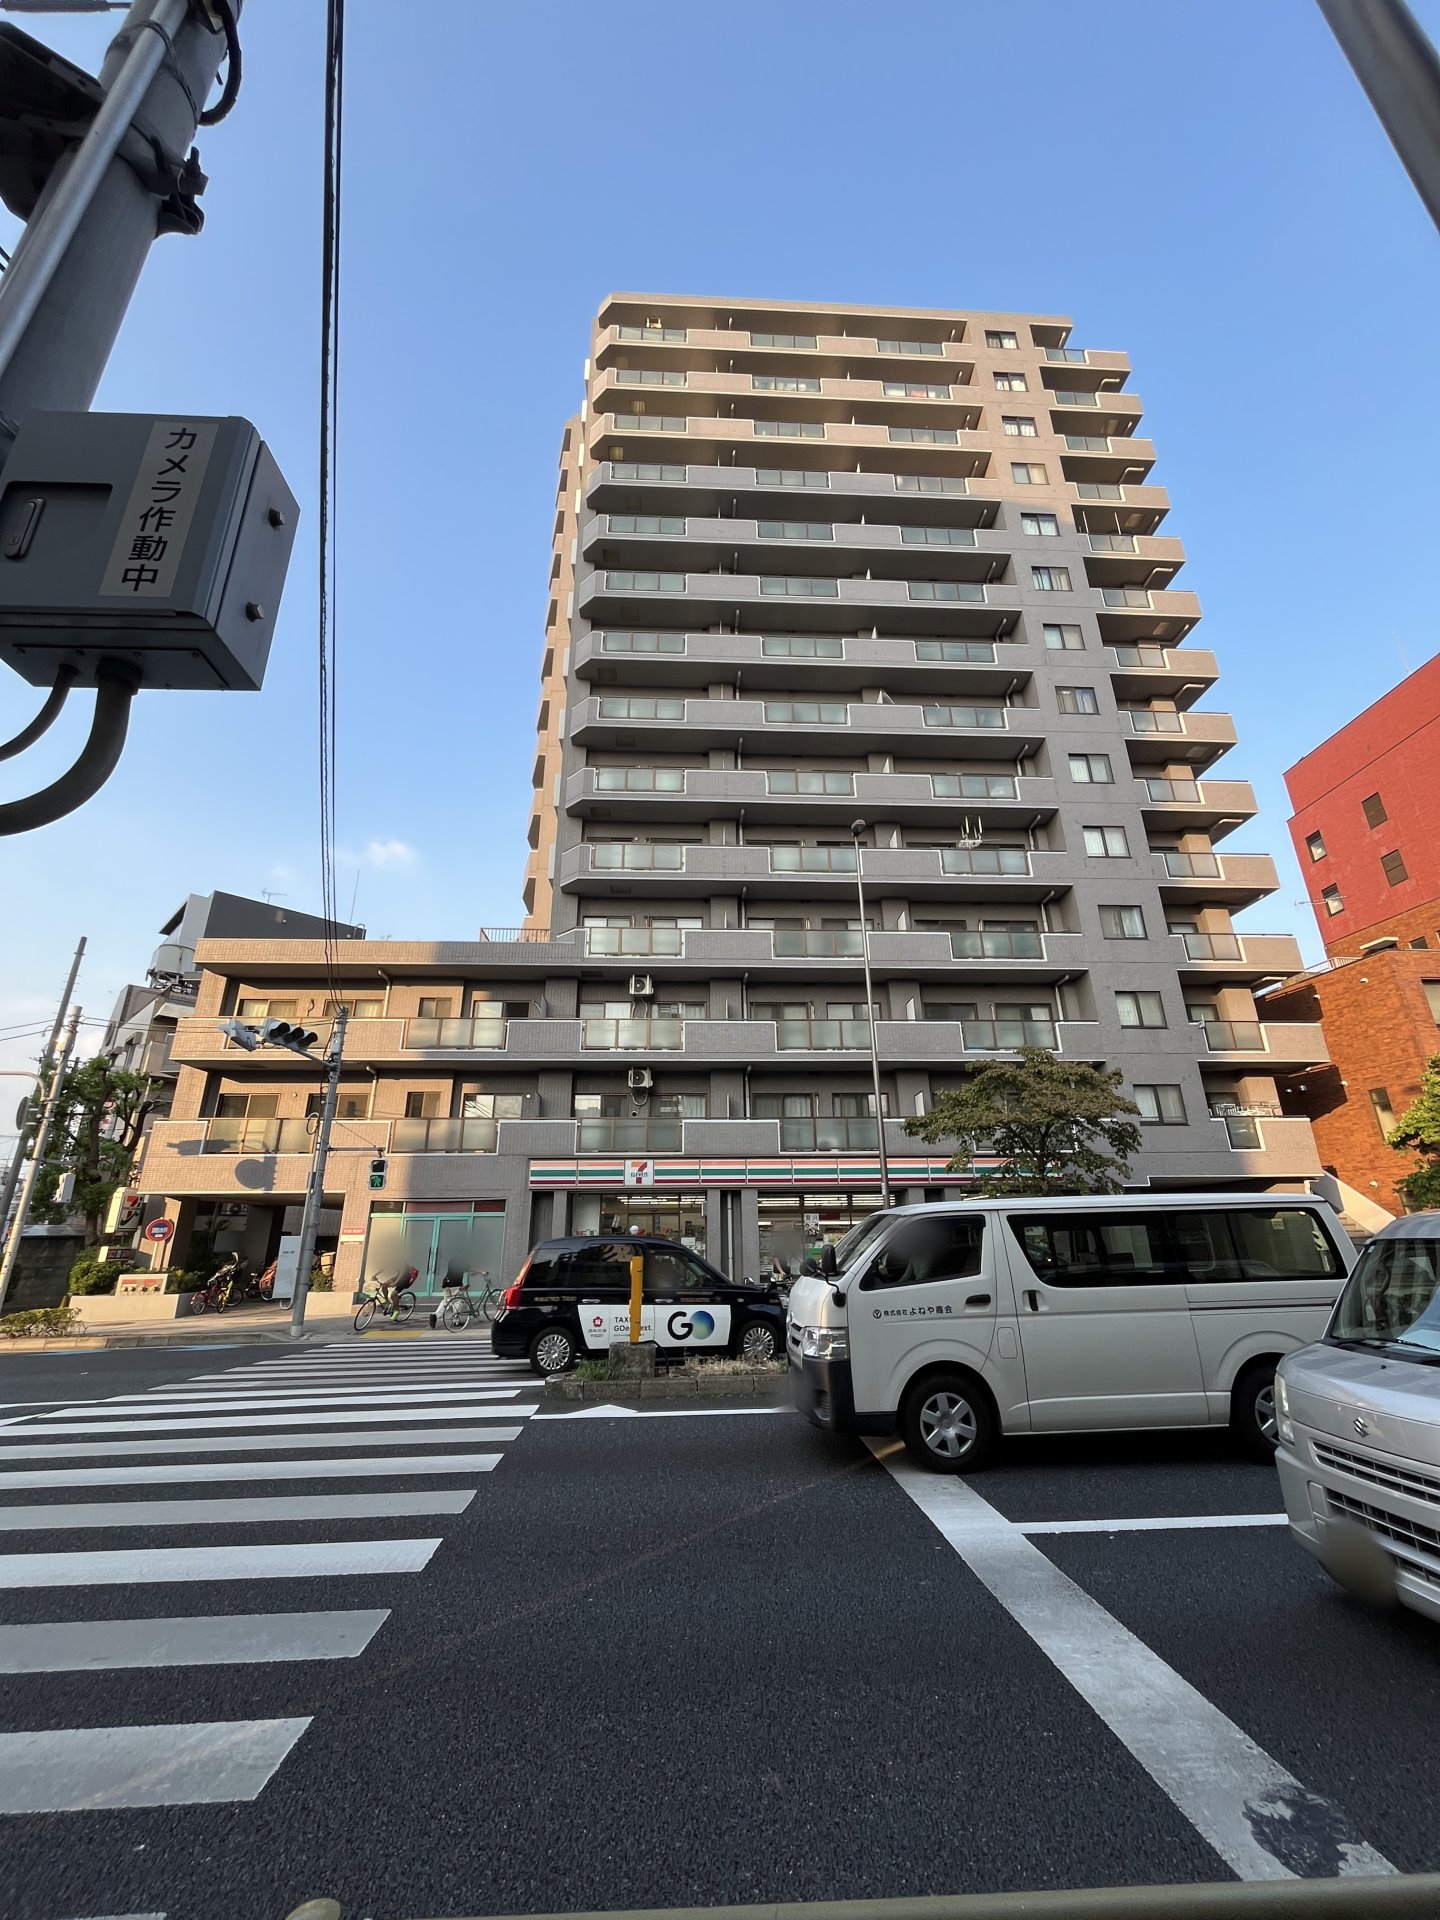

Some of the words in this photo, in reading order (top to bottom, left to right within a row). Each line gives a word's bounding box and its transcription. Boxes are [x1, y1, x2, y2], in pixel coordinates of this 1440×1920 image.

[121, 427, 198, 593] カメラ作動中
[667, 1311, 715, 1340] GO
